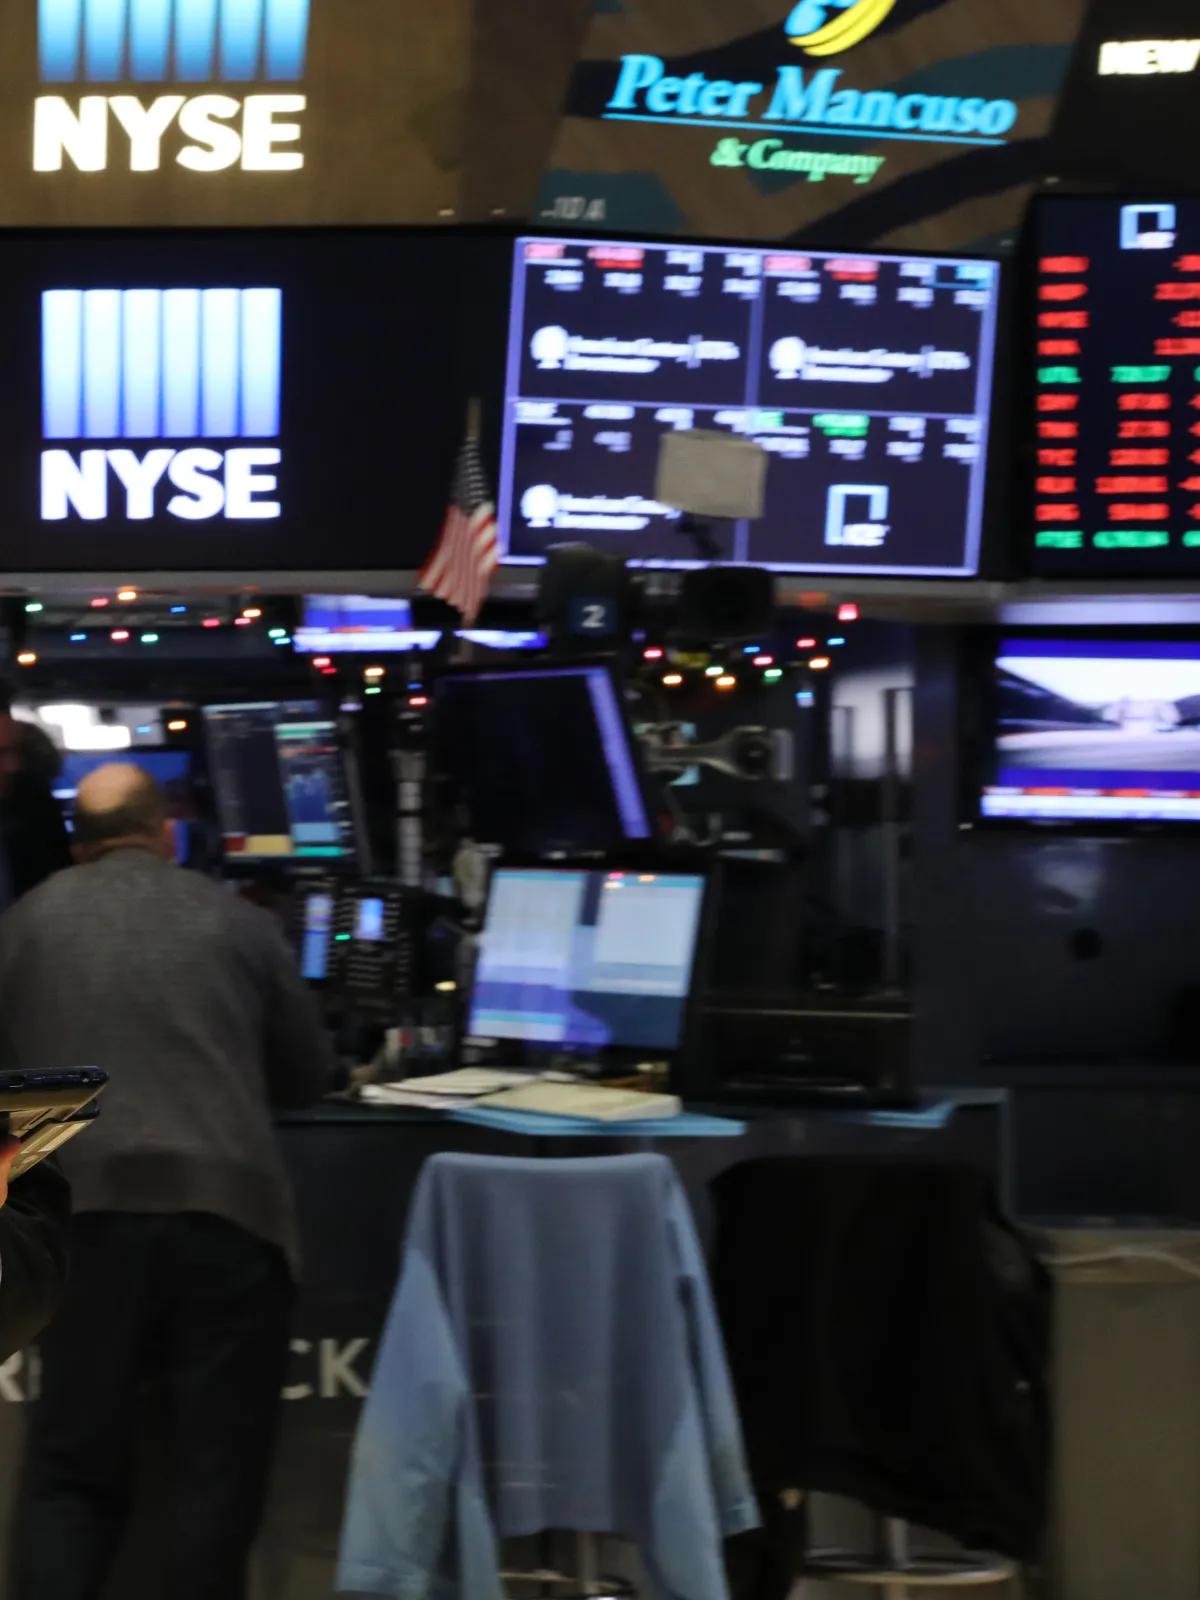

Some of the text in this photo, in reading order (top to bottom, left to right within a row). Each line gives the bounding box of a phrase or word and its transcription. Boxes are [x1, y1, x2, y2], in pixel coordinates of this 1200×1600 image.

[606, 53, 1018, 135] Peter Mancuso
[33, 94, 307, 172] NYSE
[710, 137, 887, 184] & Company
[40, 447, 282, 520] NYSE
[581, 604, 606, 628] 2
